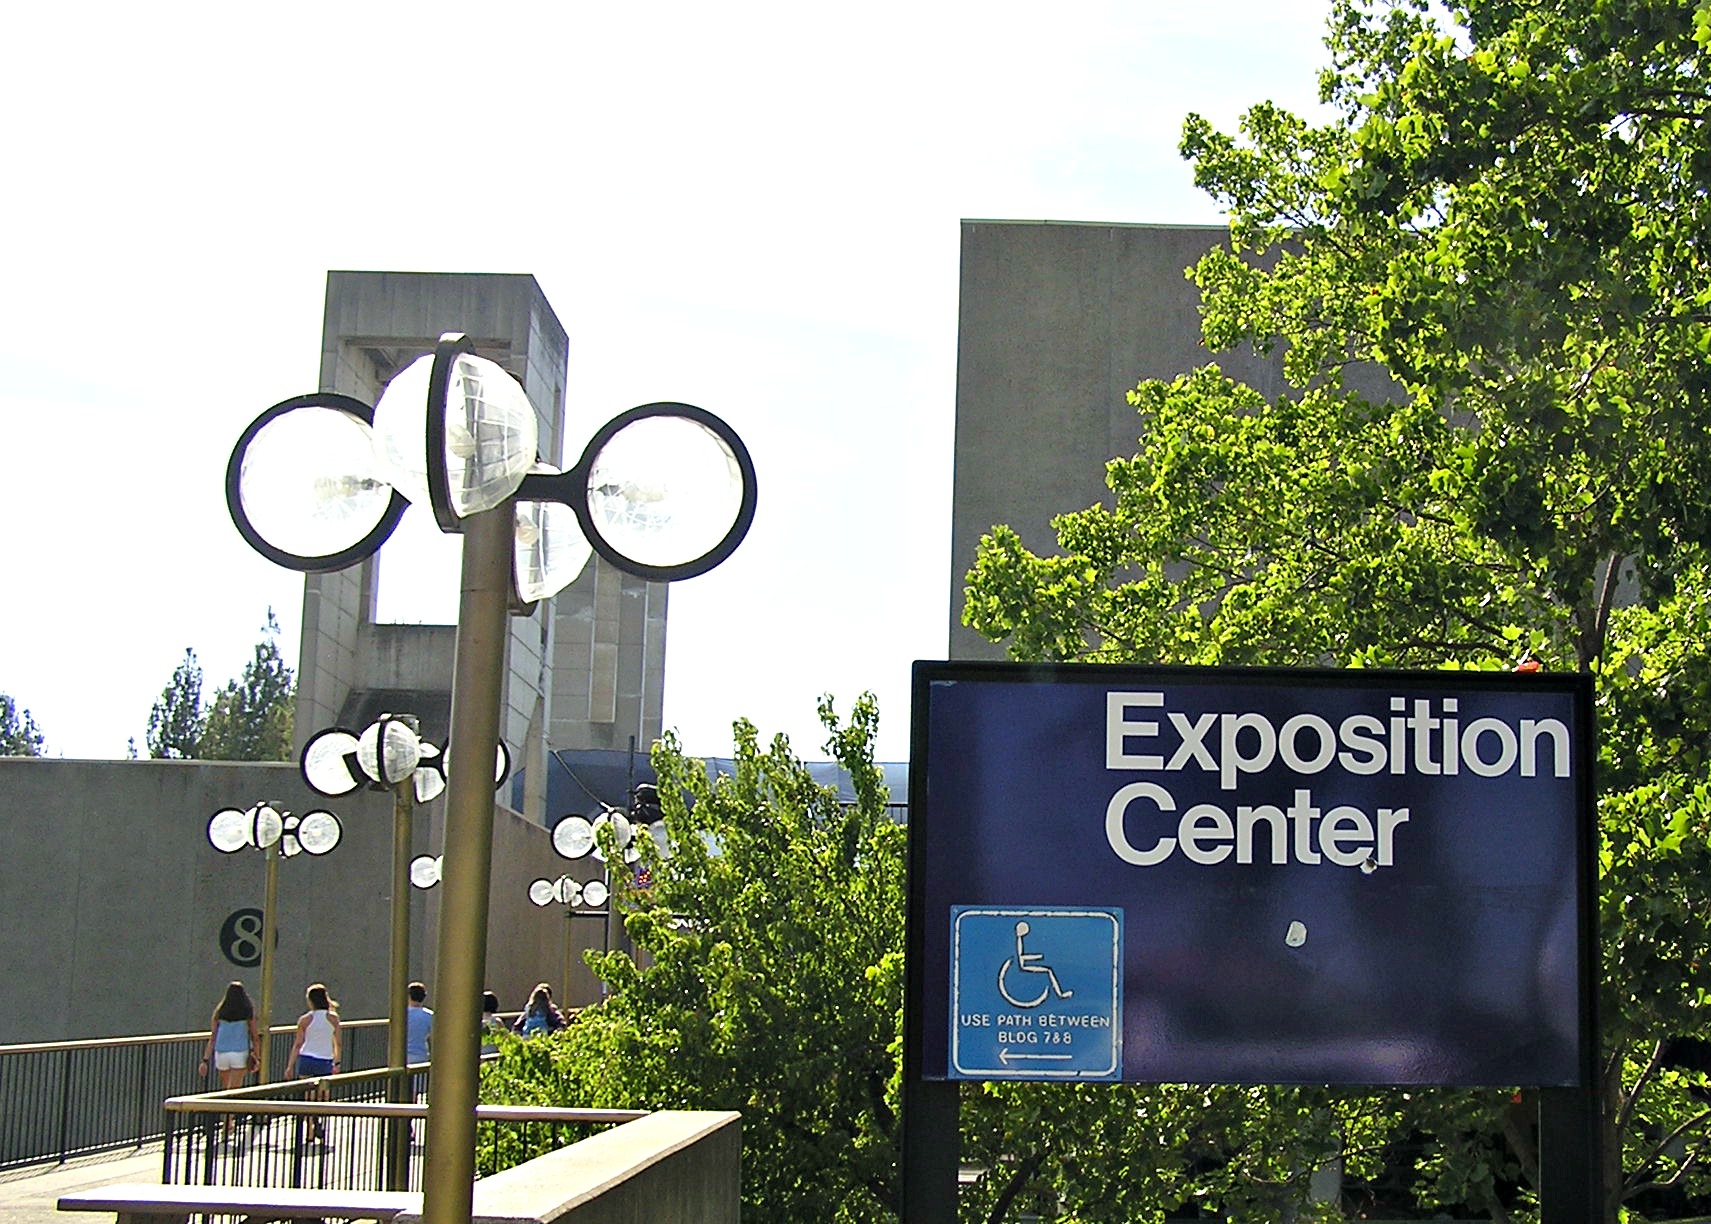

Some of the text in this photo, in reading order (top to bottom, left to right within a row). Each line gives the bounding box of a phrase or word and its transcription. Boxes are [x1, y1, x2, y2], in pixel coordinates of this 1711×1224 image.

[1105, 691, 1571, 790] Exposition
[1104, 781, 1410, 867] Center
[231, 915, 263, 962] 8
[960, 1014, 1110, 1028] USE PATH BETWEEN
[998, 1031, 1038, 1044] BLDG
